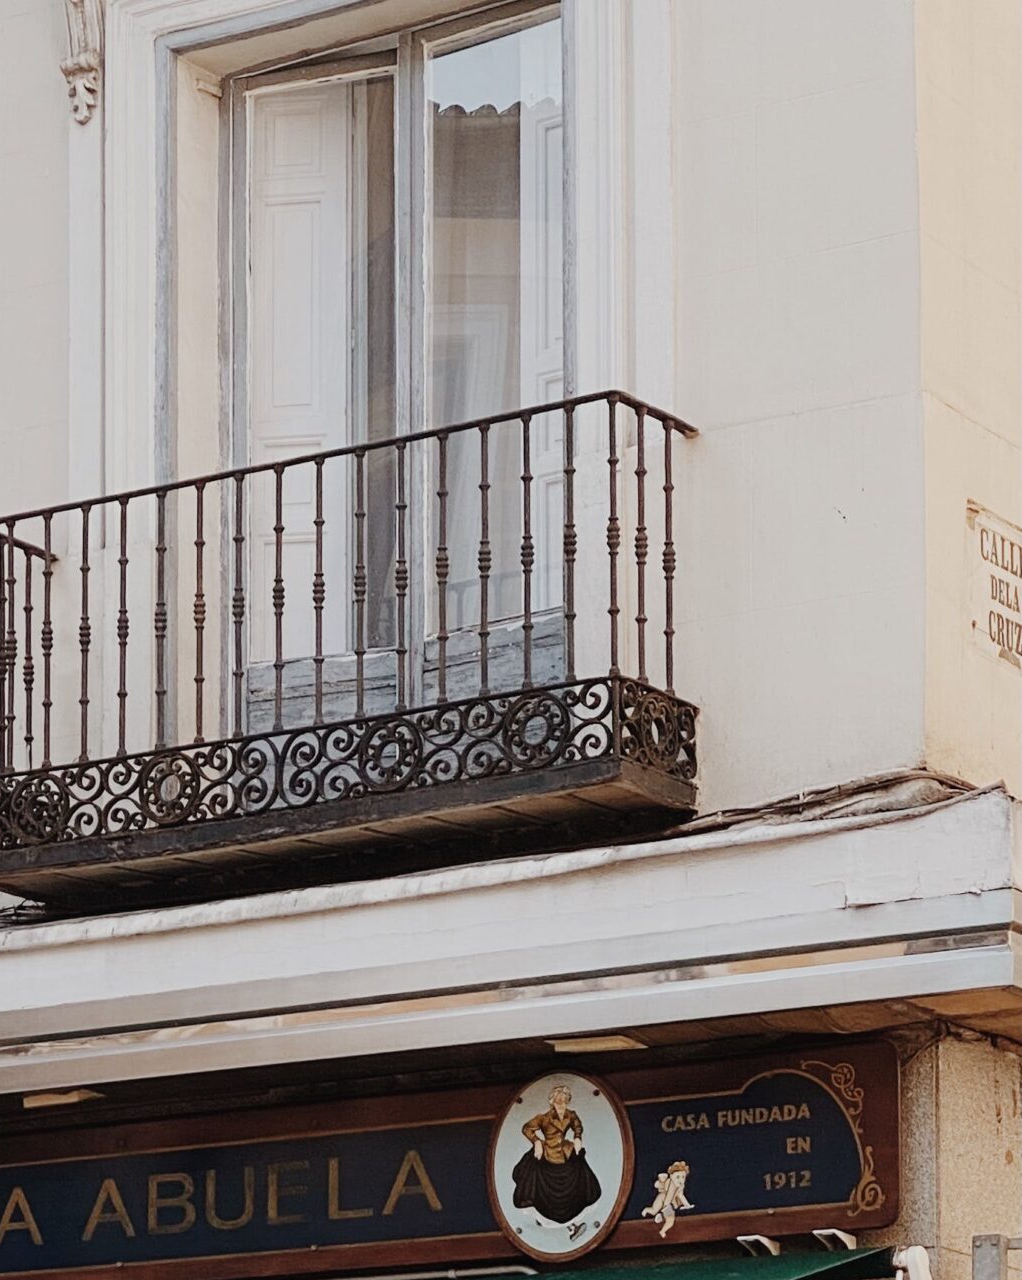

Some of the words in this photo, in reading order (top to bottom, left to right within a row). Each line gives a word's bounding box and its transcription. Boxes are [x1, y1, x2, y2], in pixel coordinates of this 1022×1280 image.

[661, 1112, 710, 1133] CASA
[717, 1103, 811, 1127] FUNDADA
[786, 1136, 811, 1154] EN
[763, 1170, 811, 1191] 1912
[81, 1150, 444, 1242] ABUELA
